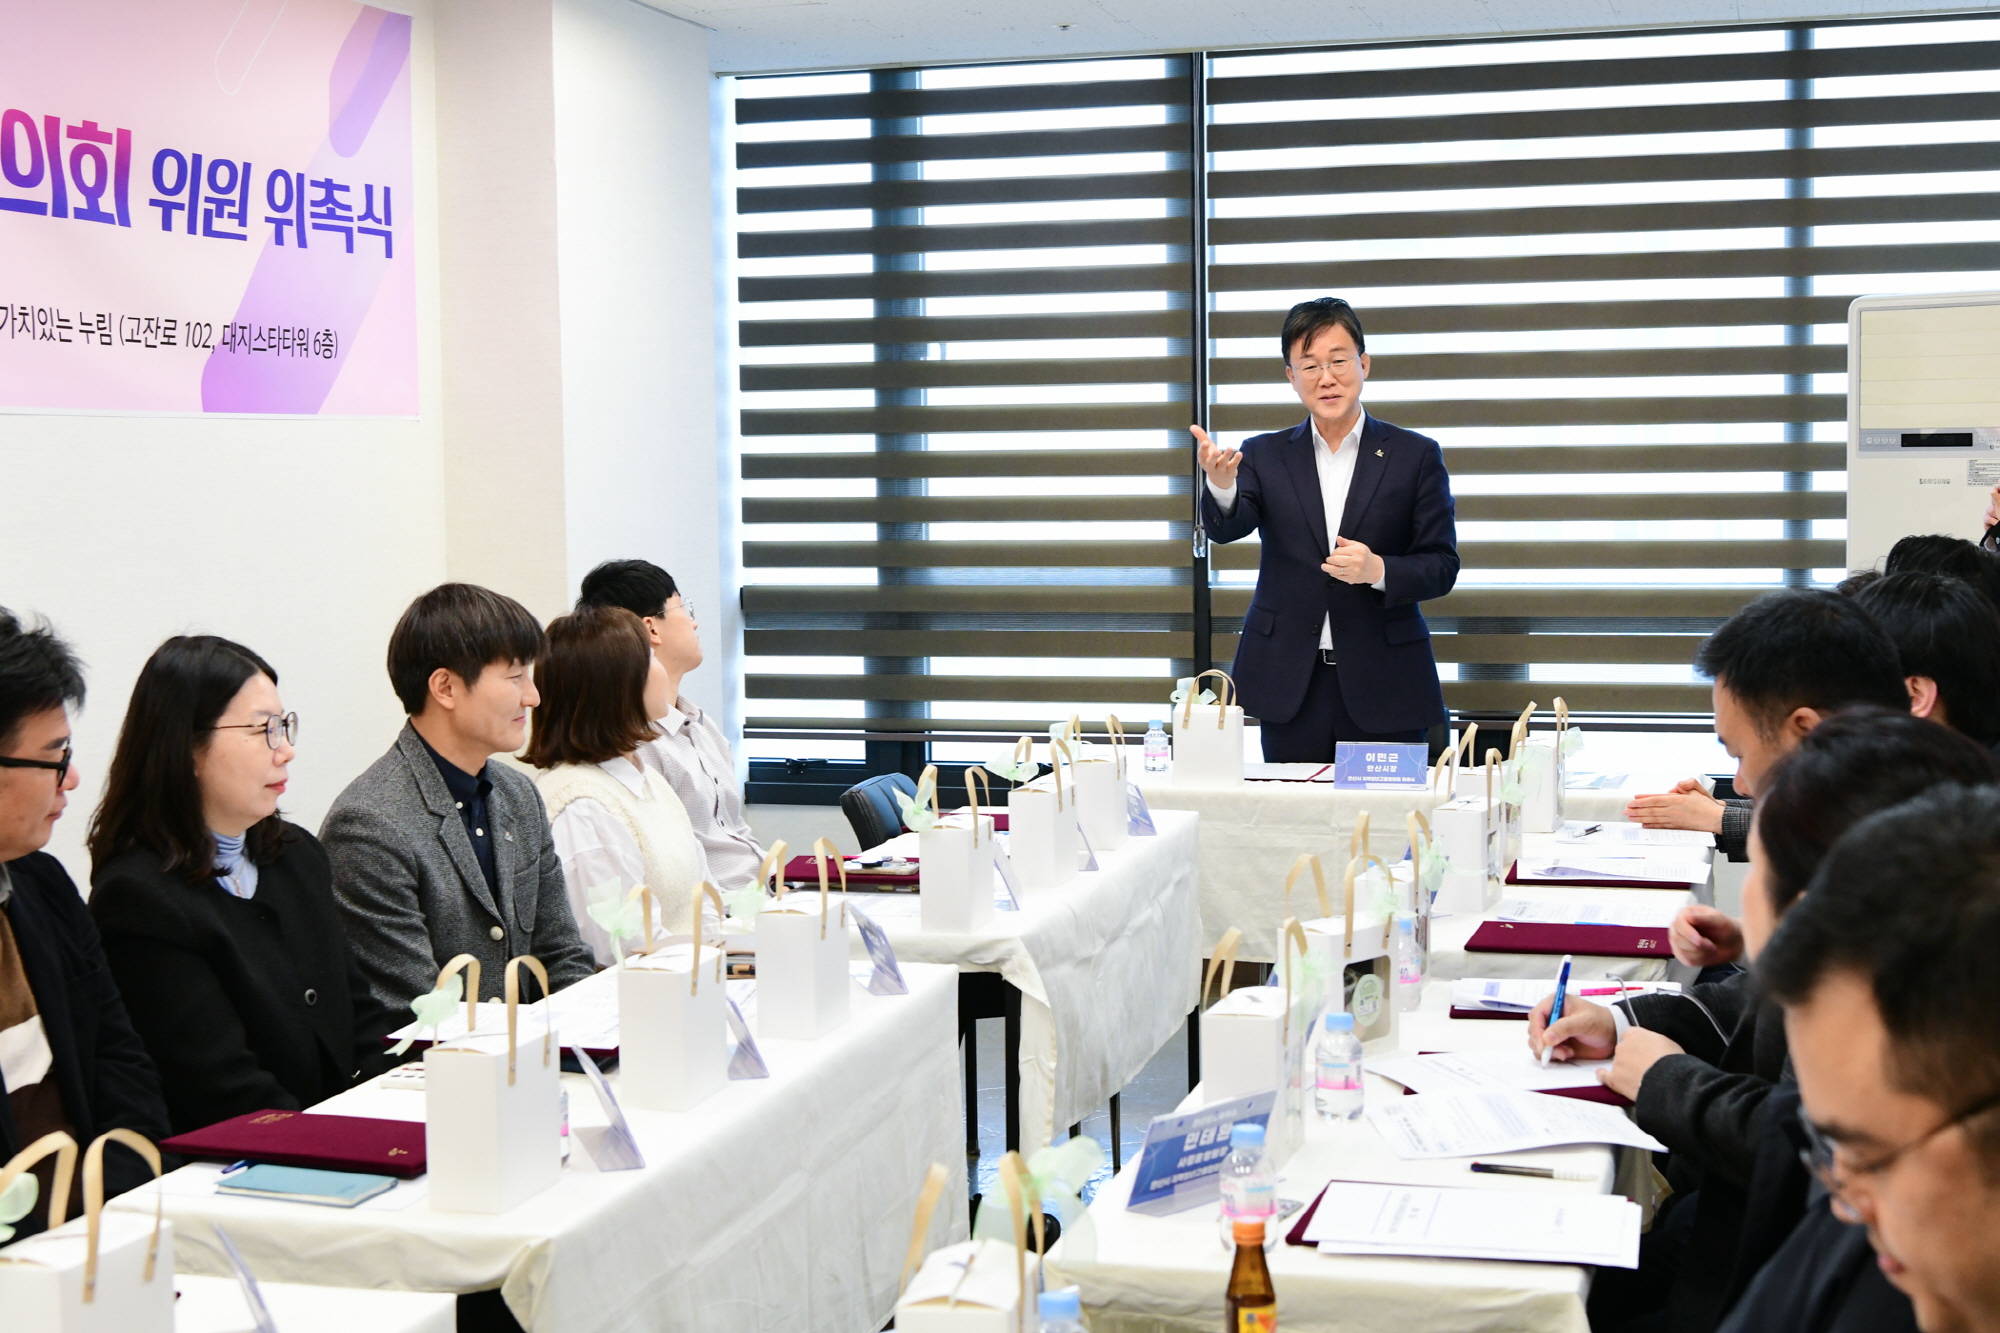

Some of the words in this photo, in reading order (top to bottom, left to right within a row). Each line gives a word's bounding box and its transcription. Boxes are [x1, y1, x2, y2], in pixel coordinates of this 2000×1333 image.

[0, 108, 132, 228] 의회
[149, 148, 252, 241] 위원
[264, 168, 393, 259] 위촉식
[0, 303, 73, 343] 가치있는
[78, 311, 113, 346] 누림
[119, 314, 177, 349] (고잔로
[185, 321, 216, 354] 102,
[221, 321, 310, 358] 대지스타타워
[313, 328, 338, 359] 6층)
[1365, 752, 1399, 763] 이민근
[1366, 765, 1398, 773] 안산시장
